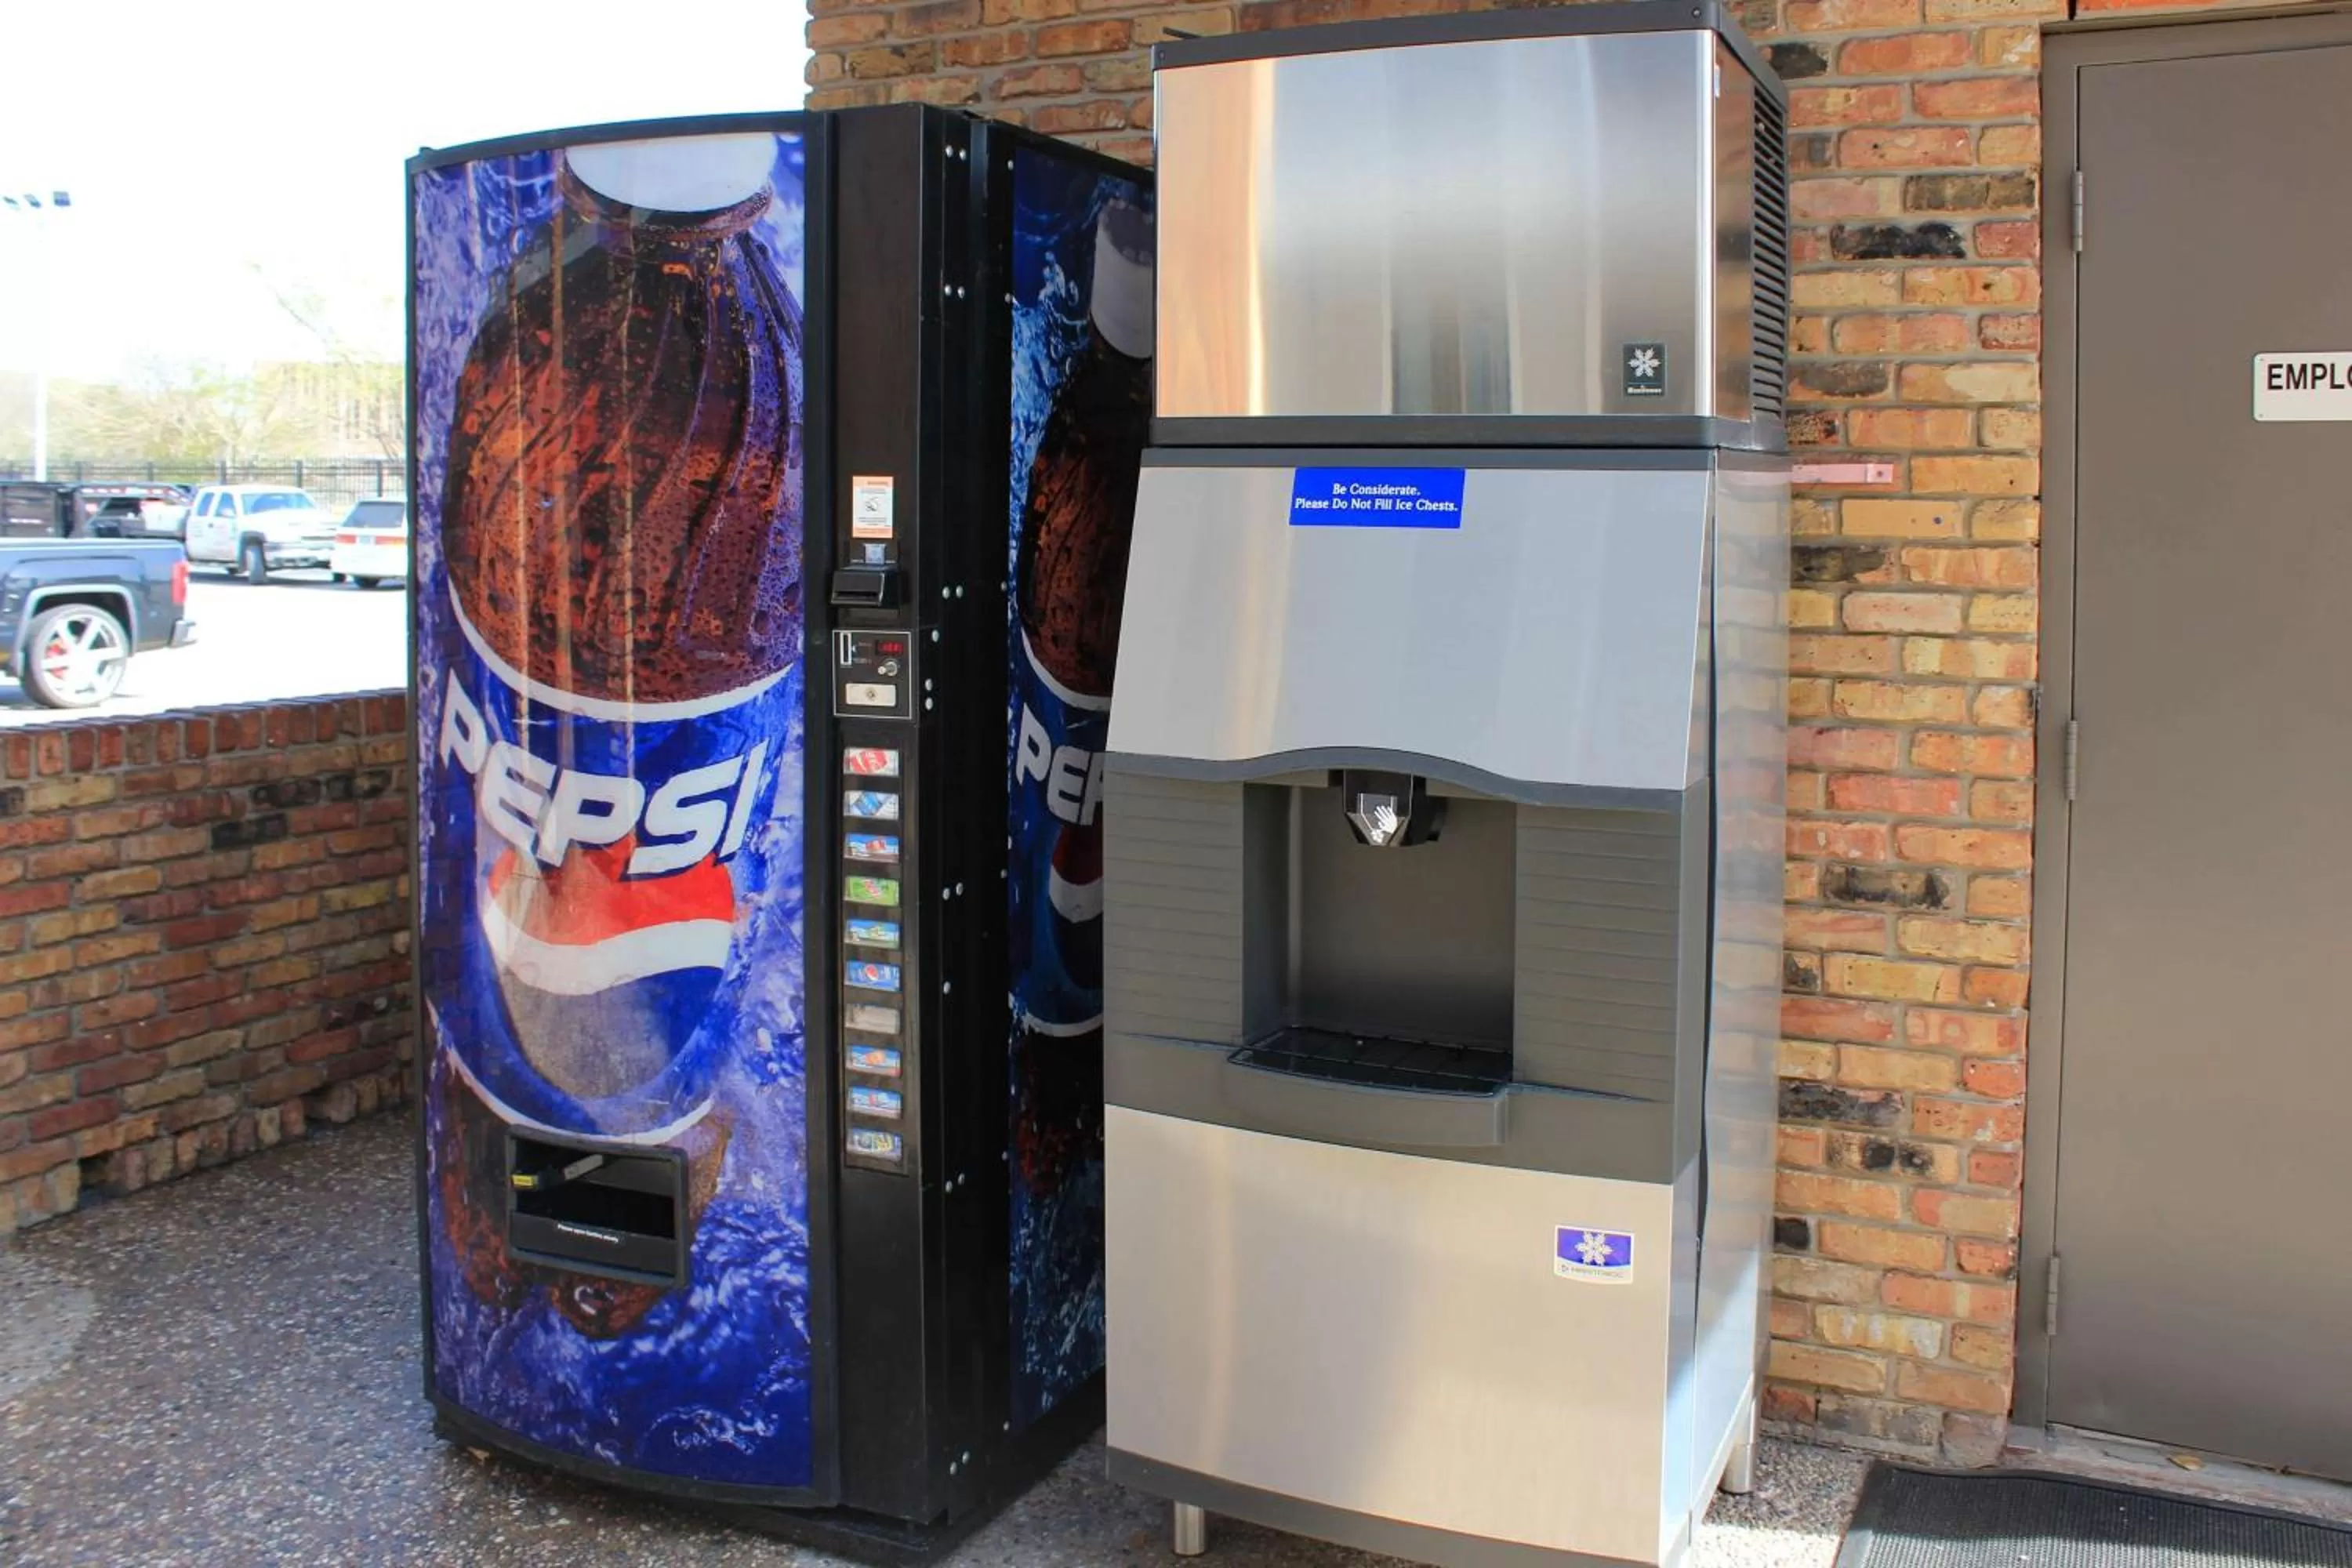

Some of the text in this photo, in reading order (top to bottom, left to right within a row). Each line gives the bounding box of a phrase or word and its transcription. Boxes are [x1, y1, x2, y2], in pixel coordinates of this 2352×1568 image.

[2267, 362, 2352, 390] EMPL
[1333, 483, 1421, 495] Be Considerate.
[1295, 498, 1457, 512] Please Do Not Fill Ice Chests.
[439, 668, 770, 874] PEPSI
